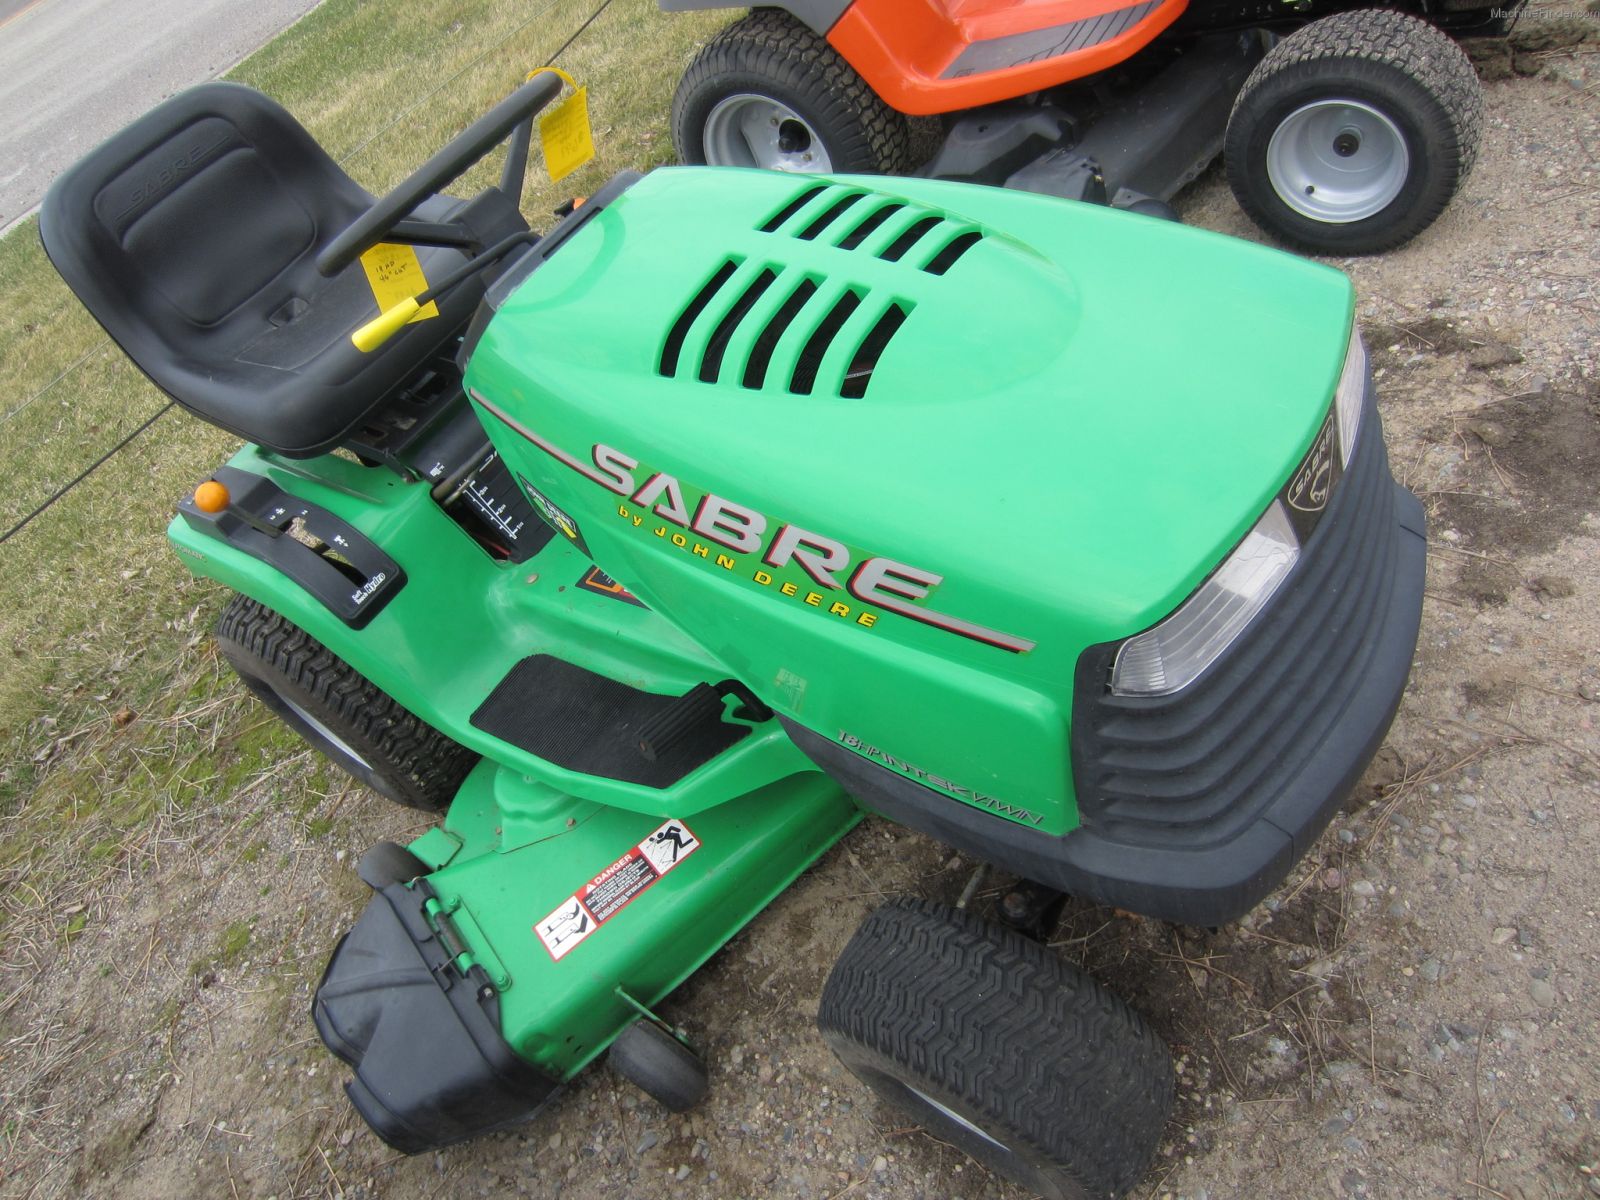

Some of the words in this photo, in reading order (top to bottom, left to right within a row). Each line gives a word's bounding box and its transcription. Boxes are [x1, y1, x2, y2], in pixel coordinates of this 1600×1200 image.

[591, 443, 944, 606] SABRE
[618, 505, 642, 527] by
[653, 527, 736, 570] JOHN
[752, 570, 878, 628] DEERE
[594, 854, 633, 885] DANGER
